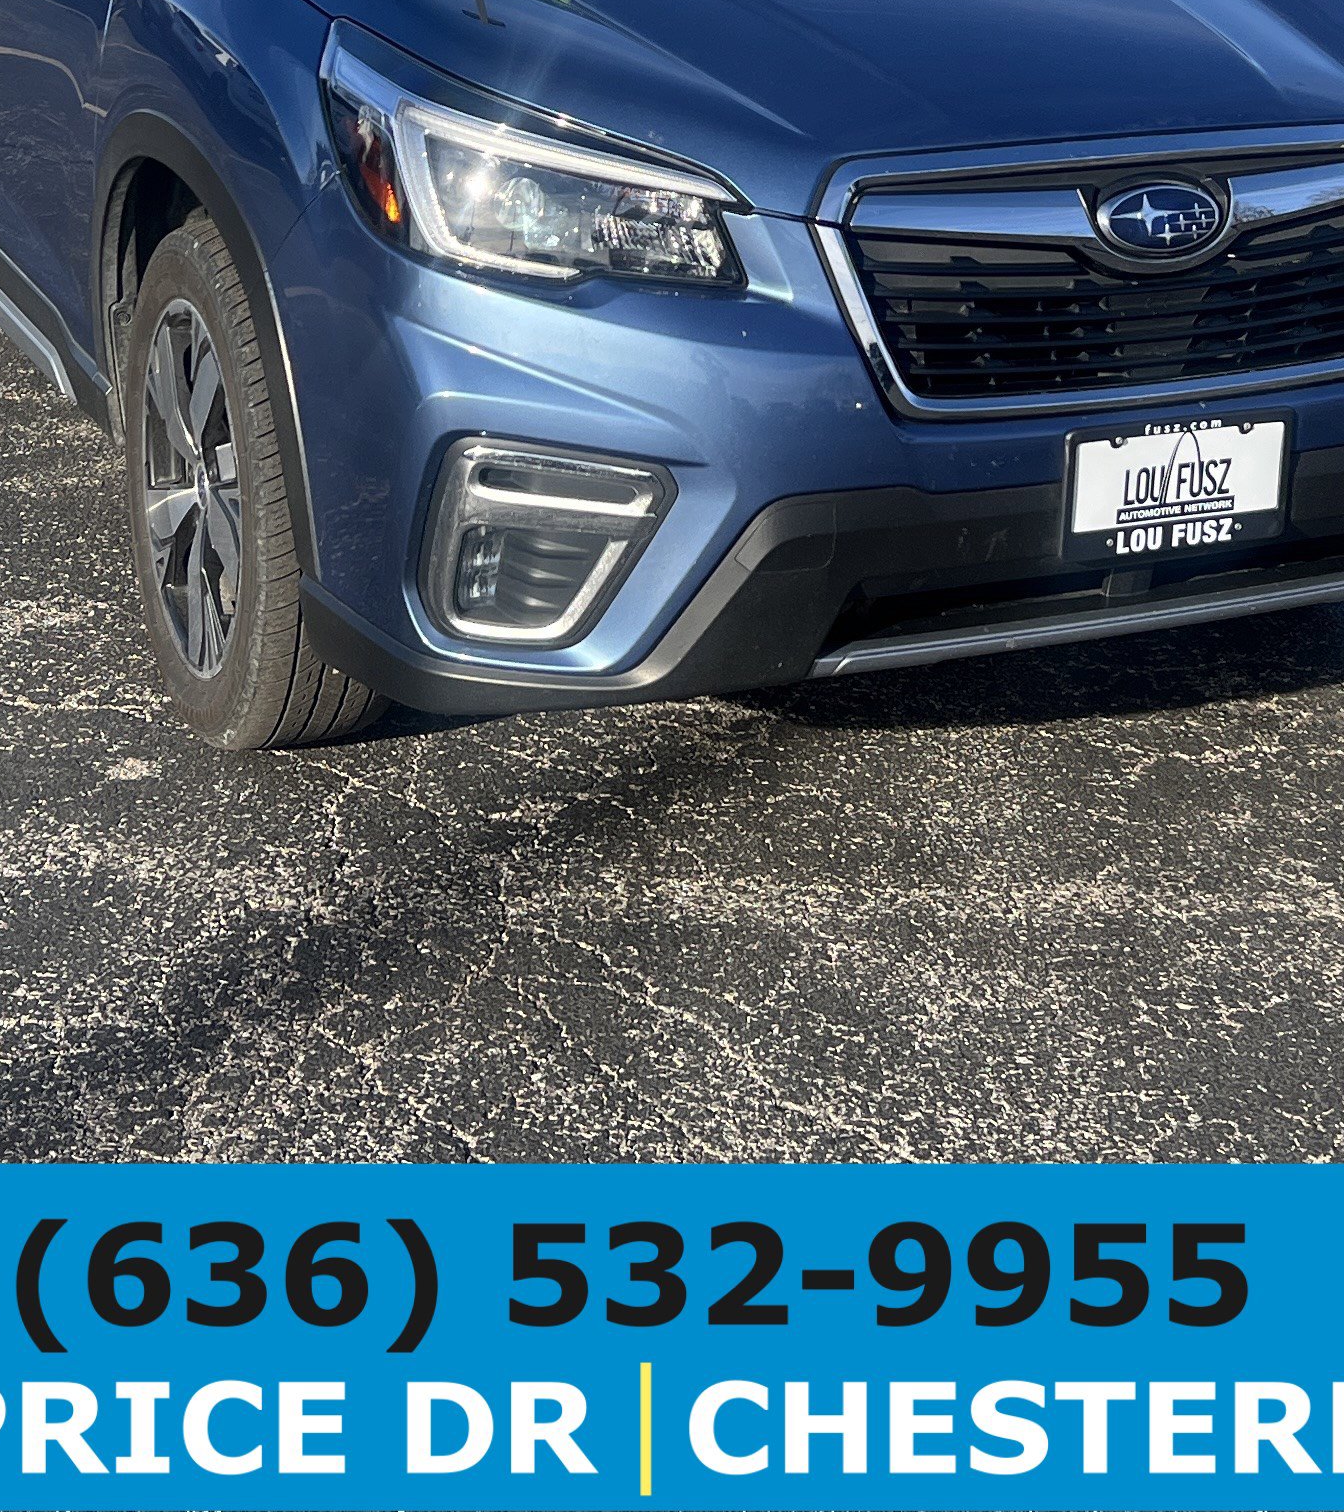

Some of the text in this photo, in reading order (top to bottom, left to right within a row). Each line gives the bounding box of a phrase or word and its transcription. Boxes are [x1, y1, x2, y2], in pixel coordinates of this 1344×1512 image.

[1144, 419, 1222, 436] fusz.com
[1123, 458, 1232, 506] LOU FUSZ
[1118, 498, 1233, 521] AUTOMOTIVE NETWORK
[1115, 517, 1233, 555] LOU FUSZ
